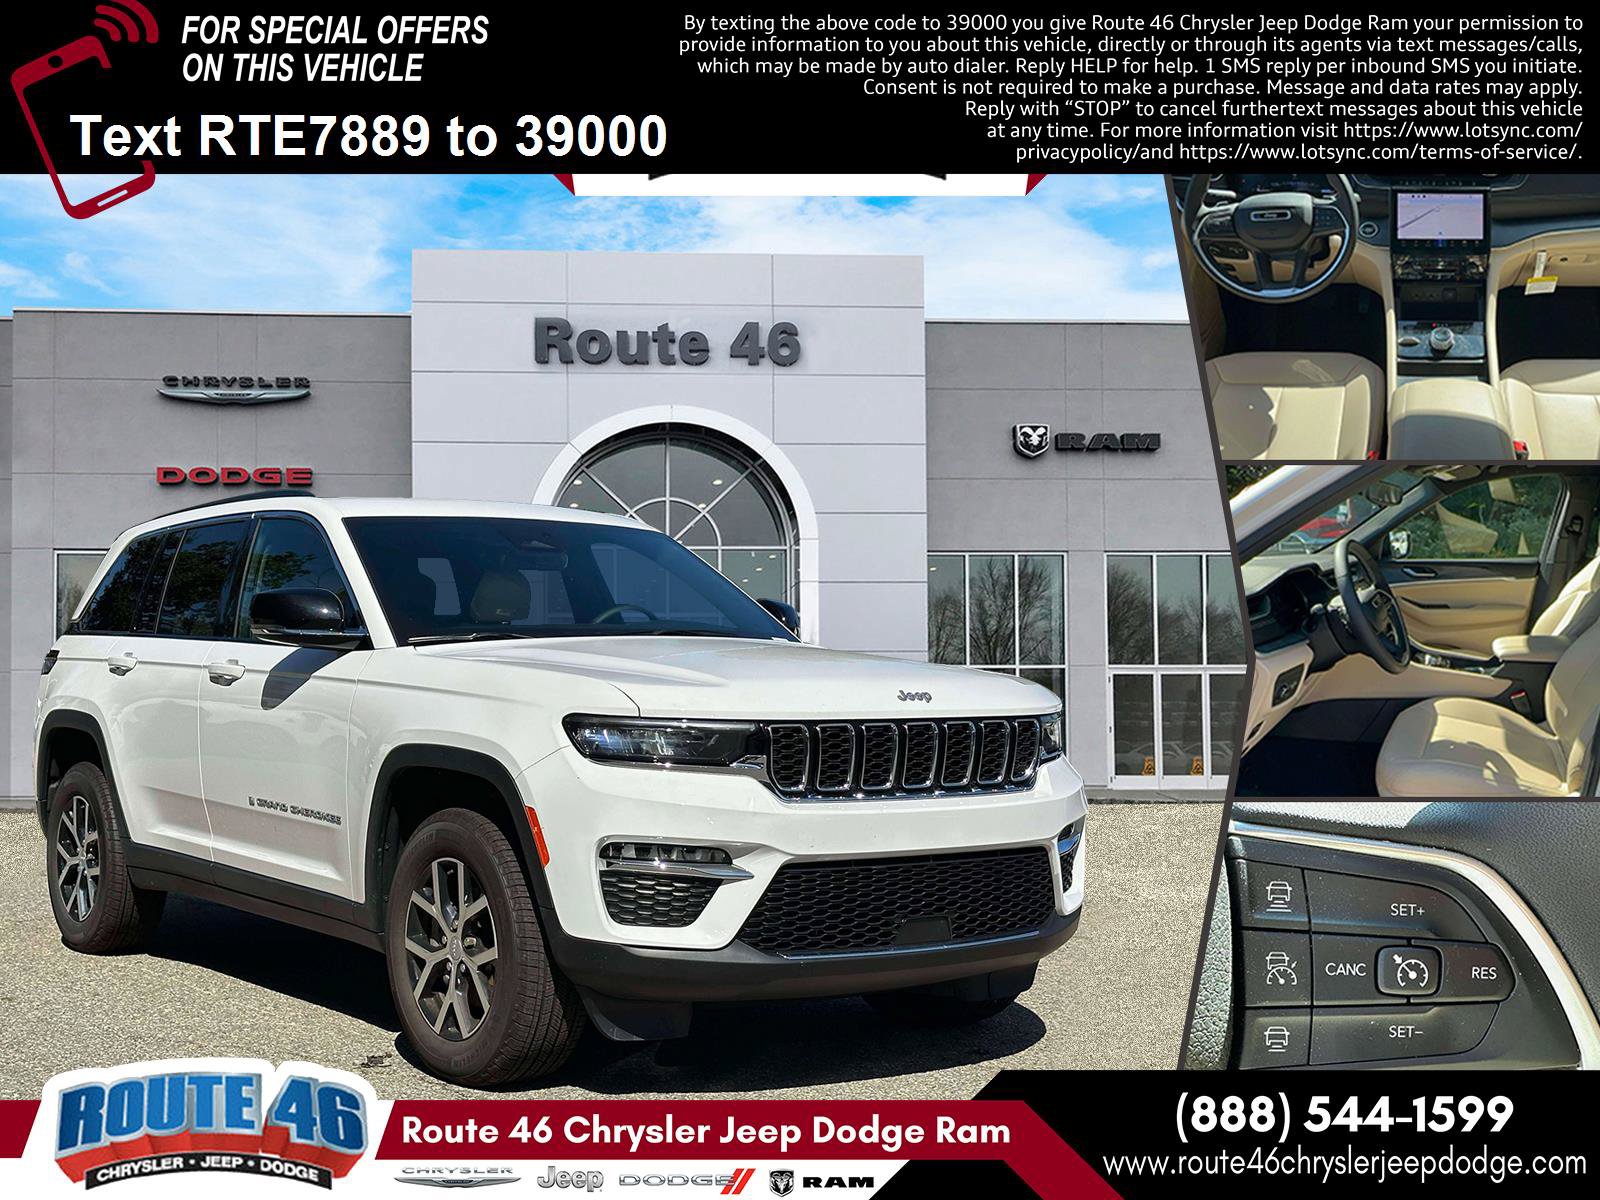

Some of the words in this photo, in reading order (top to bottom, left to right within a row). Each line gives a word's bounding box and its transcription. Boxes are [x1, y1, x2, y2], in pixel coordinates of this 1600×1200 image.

[534, 317, 710, 365] Route
[730, 321, 801, 367] 46
[162, 375, 311, 388] CHRYSLER
[1055, 432, 1162, 452] RAM
[156, 466, 313, 486] DODGE
[896, 689, 933, 703] Jeep
[1390, 903, 1425, 917] SET+
[1325, 962, 1367, 977] CANC
[1471, 967, 1497, 980] RES
